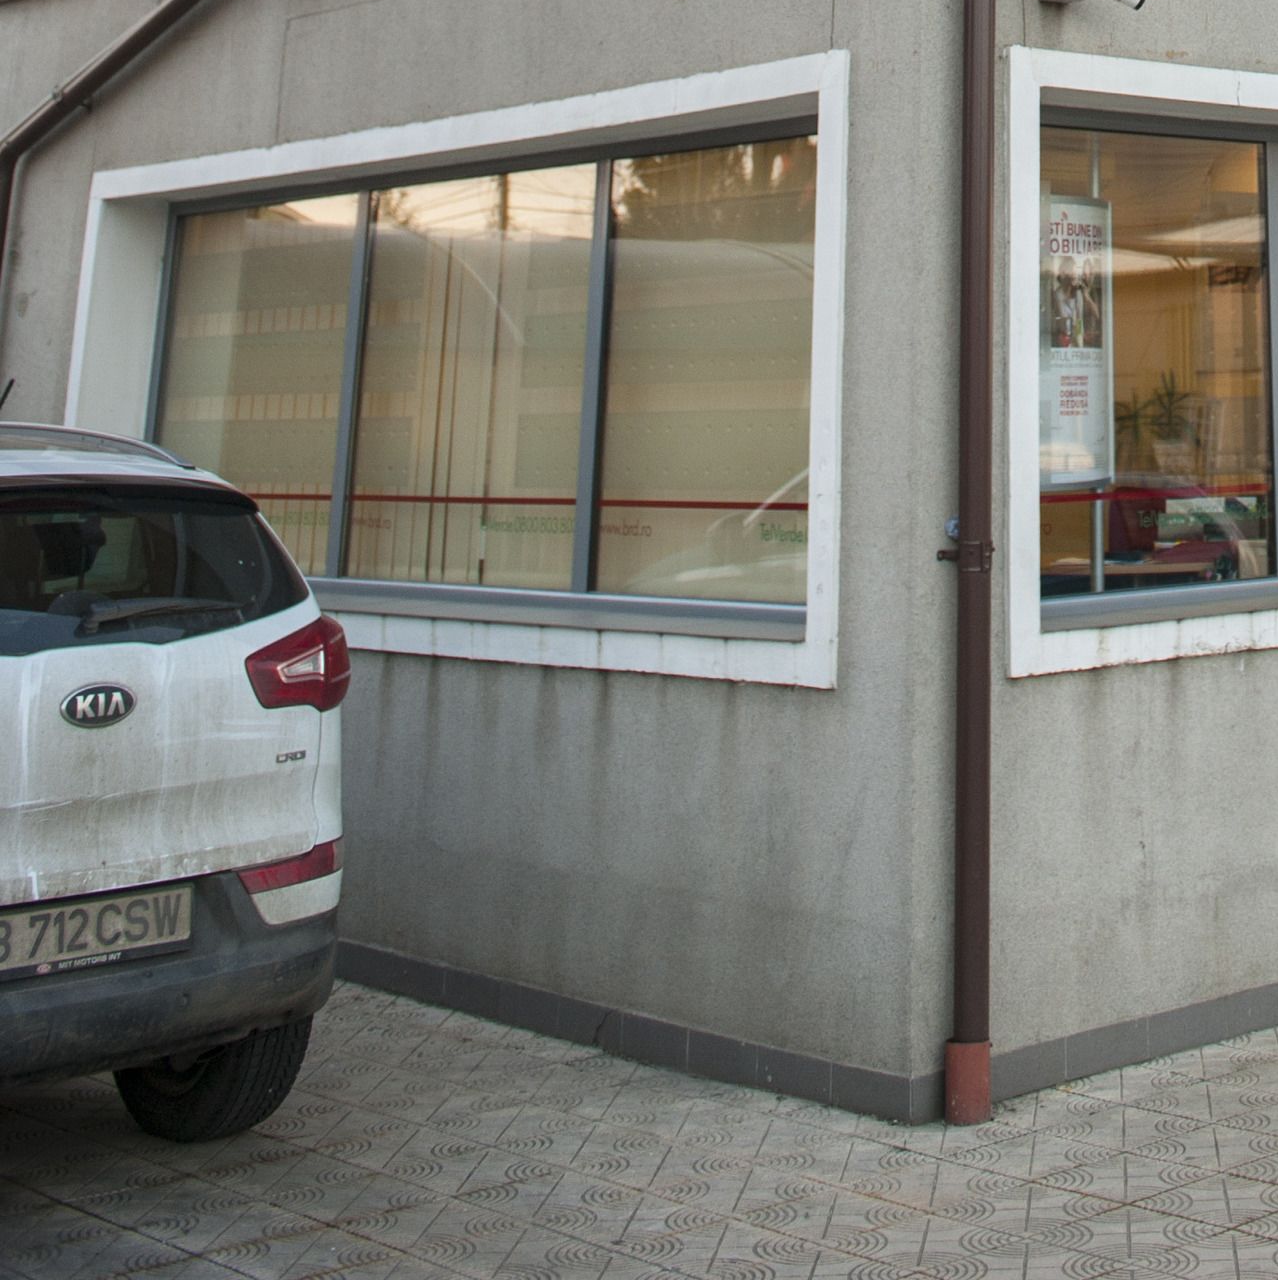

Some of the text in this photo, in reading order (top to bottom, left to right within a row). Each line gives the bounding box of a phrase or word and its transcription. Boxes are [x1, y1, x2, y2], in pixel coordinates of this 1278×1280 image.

[75, 691, 126, 719] KIA
[28, 907, 90, 959] 712
[96, 893, 182, 946] CSW
